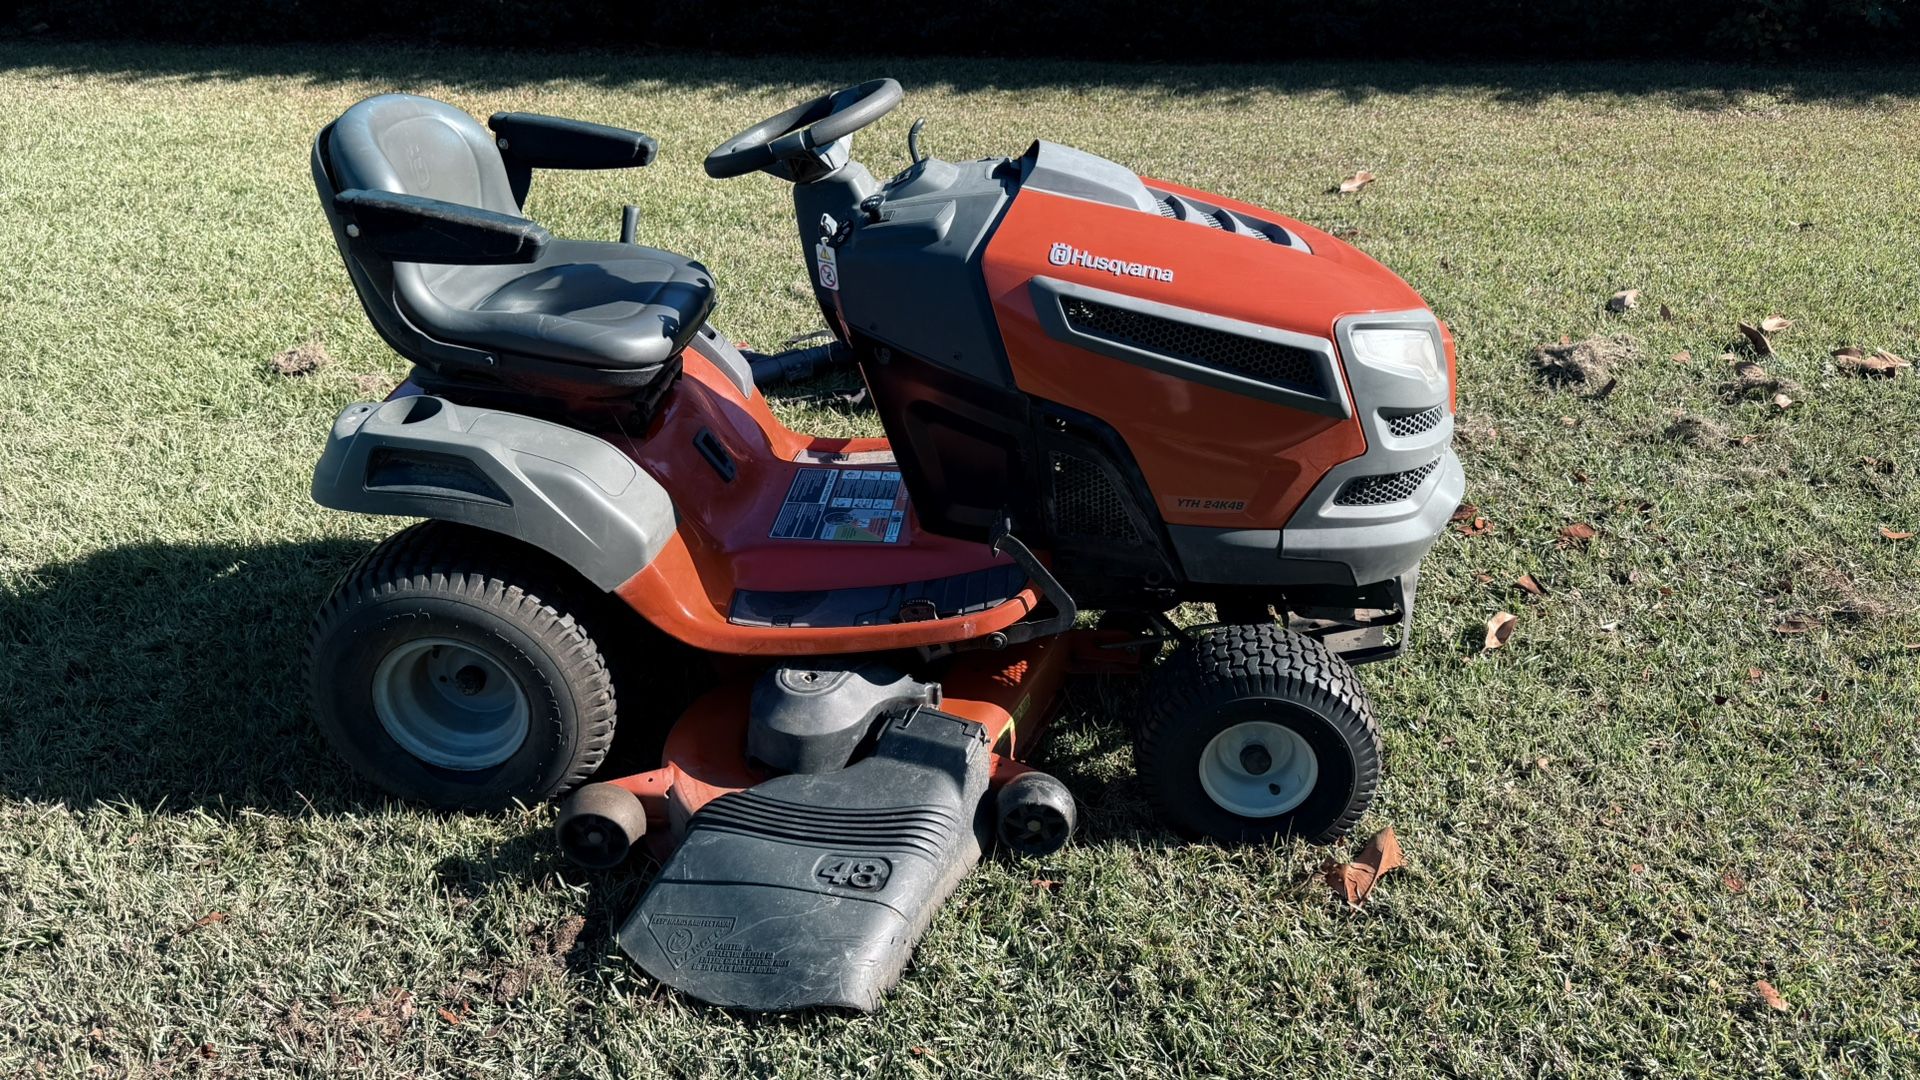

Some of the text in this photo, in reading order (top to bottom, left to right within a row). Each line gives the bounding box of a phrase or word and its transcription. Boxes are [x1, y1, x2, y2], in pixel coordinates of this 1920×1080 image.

[1071, 248, 1174, 282] Husqvarna
[1177, 498, 1245, 511] YTH 24K48
[817, 857, 883, 889] 48
